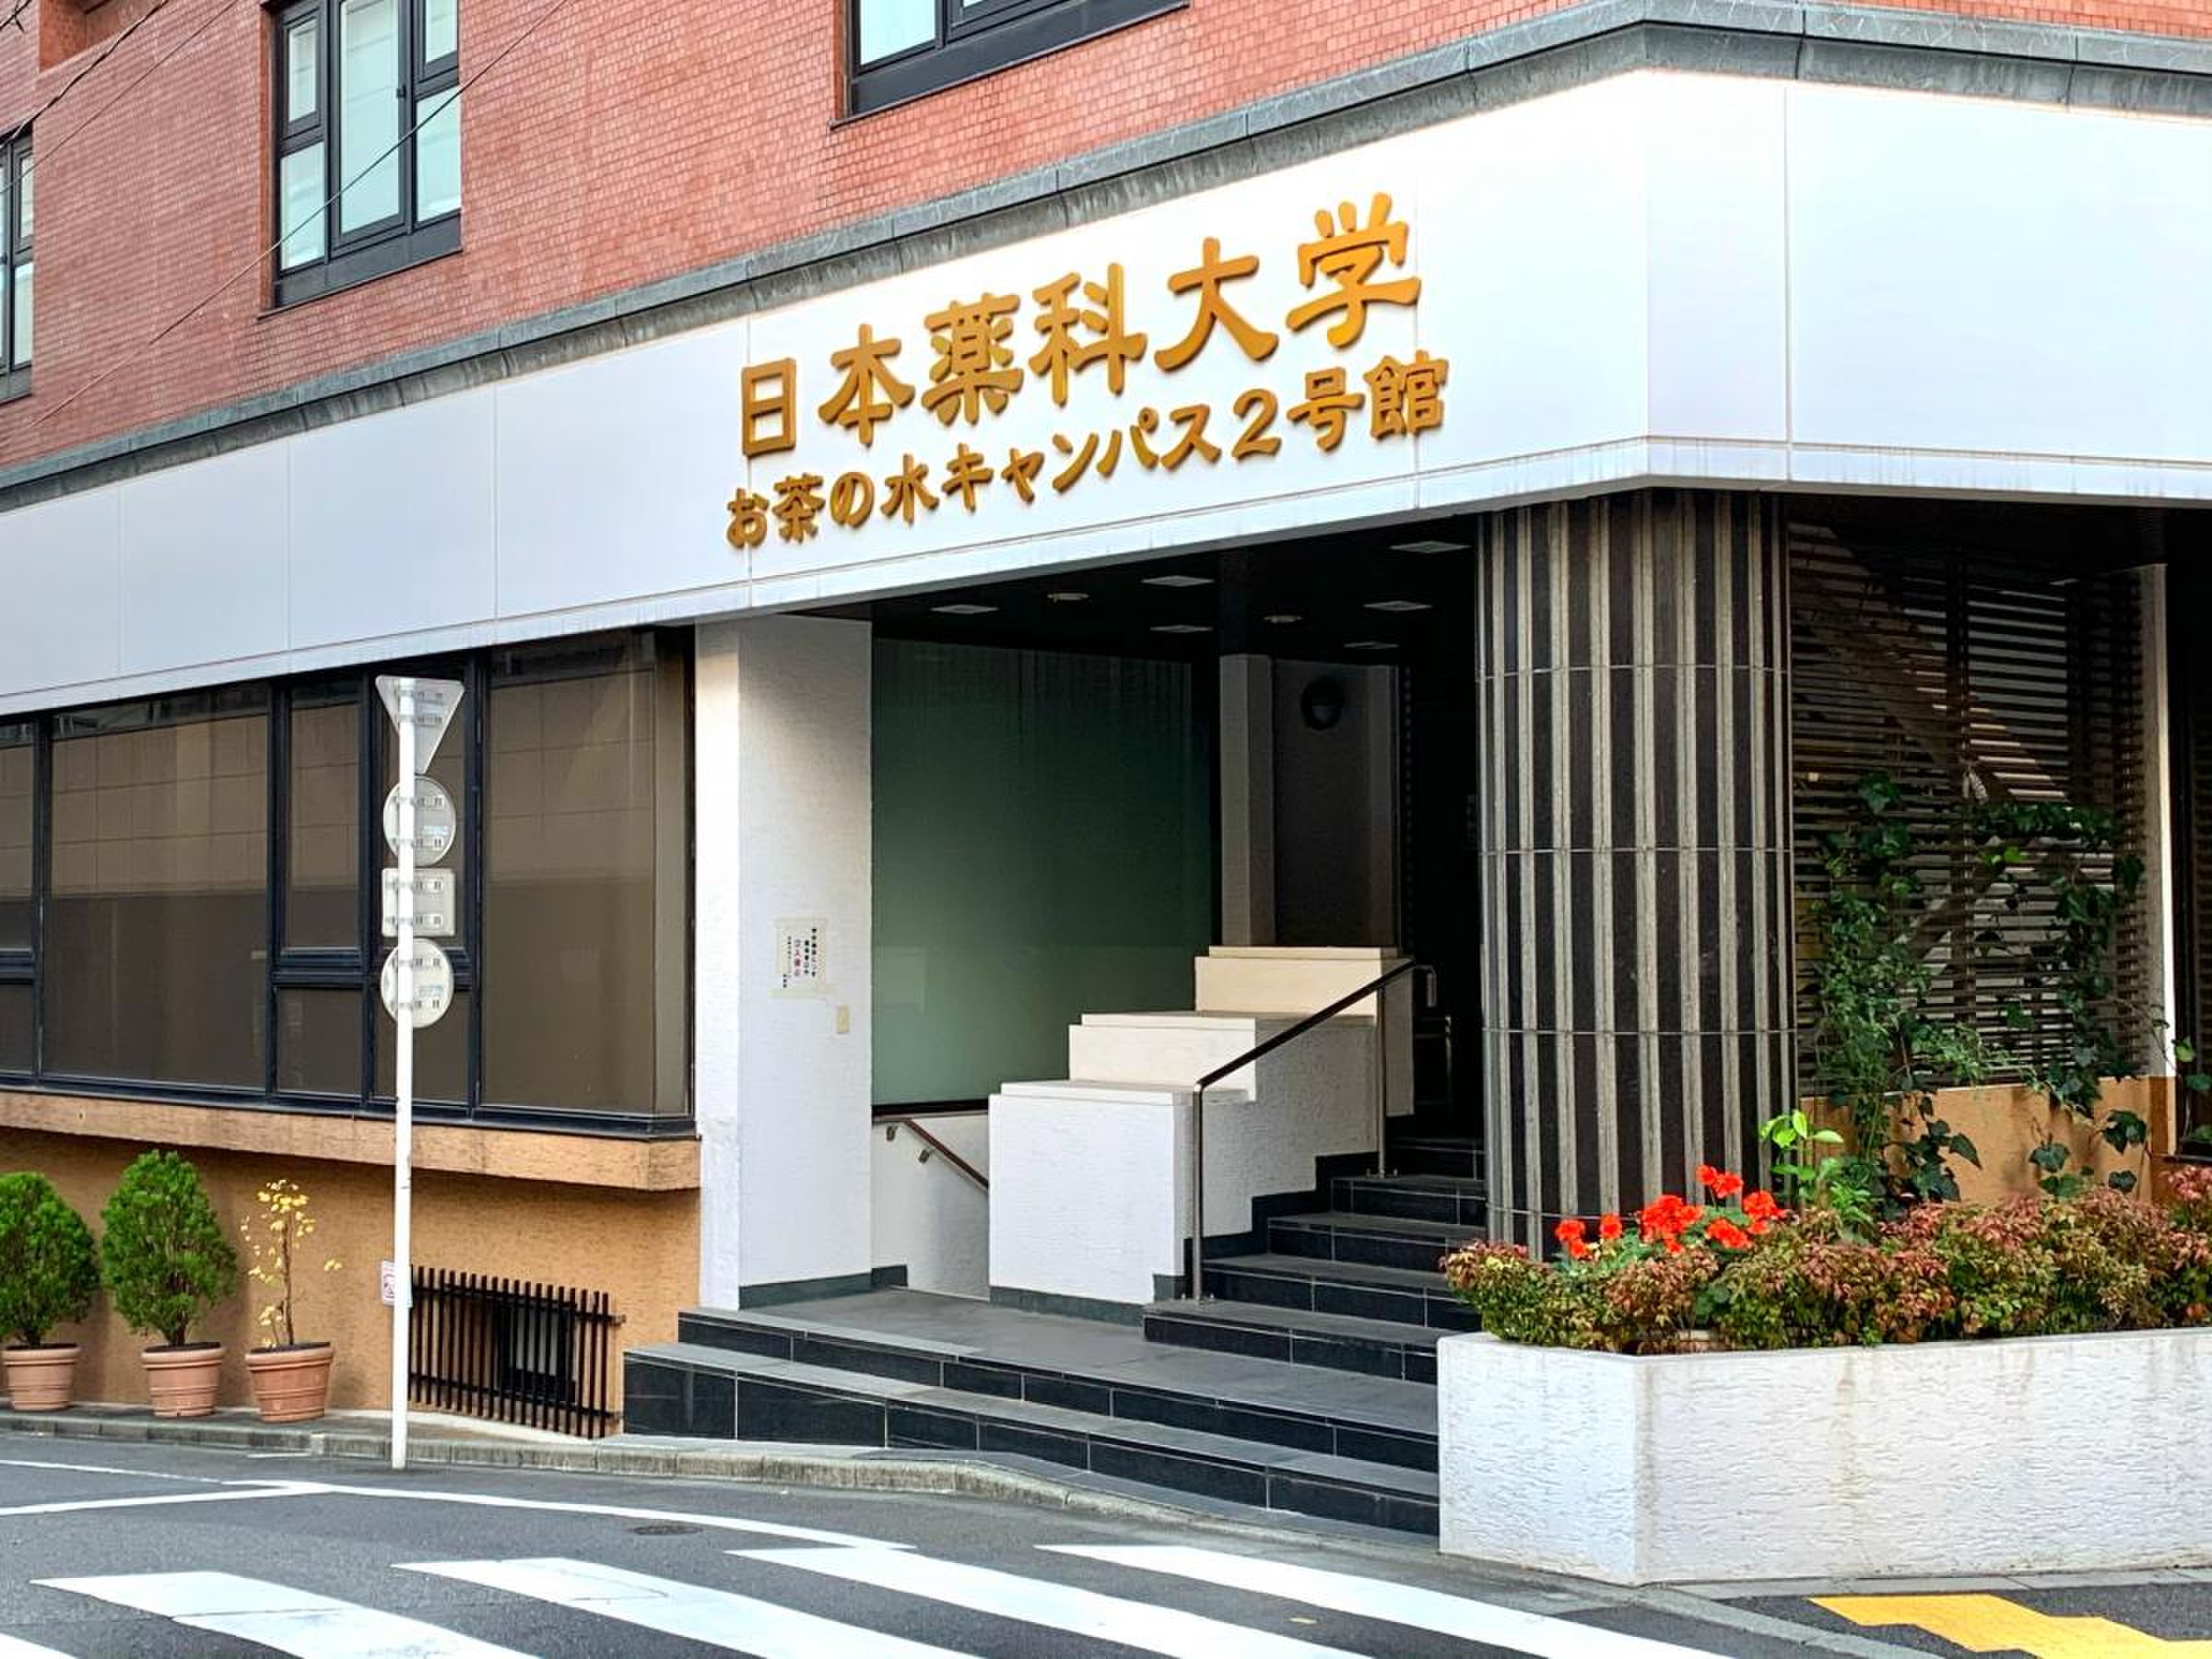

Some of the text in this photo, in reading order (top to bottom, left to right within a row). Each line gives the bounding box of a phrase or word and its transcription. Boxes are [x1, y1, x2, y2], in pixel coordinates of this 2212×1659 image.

[742, 193, 1422, 460] 日本薬科大学
[726, 349, 1449, 549] お茶の水キャンパス2号館
